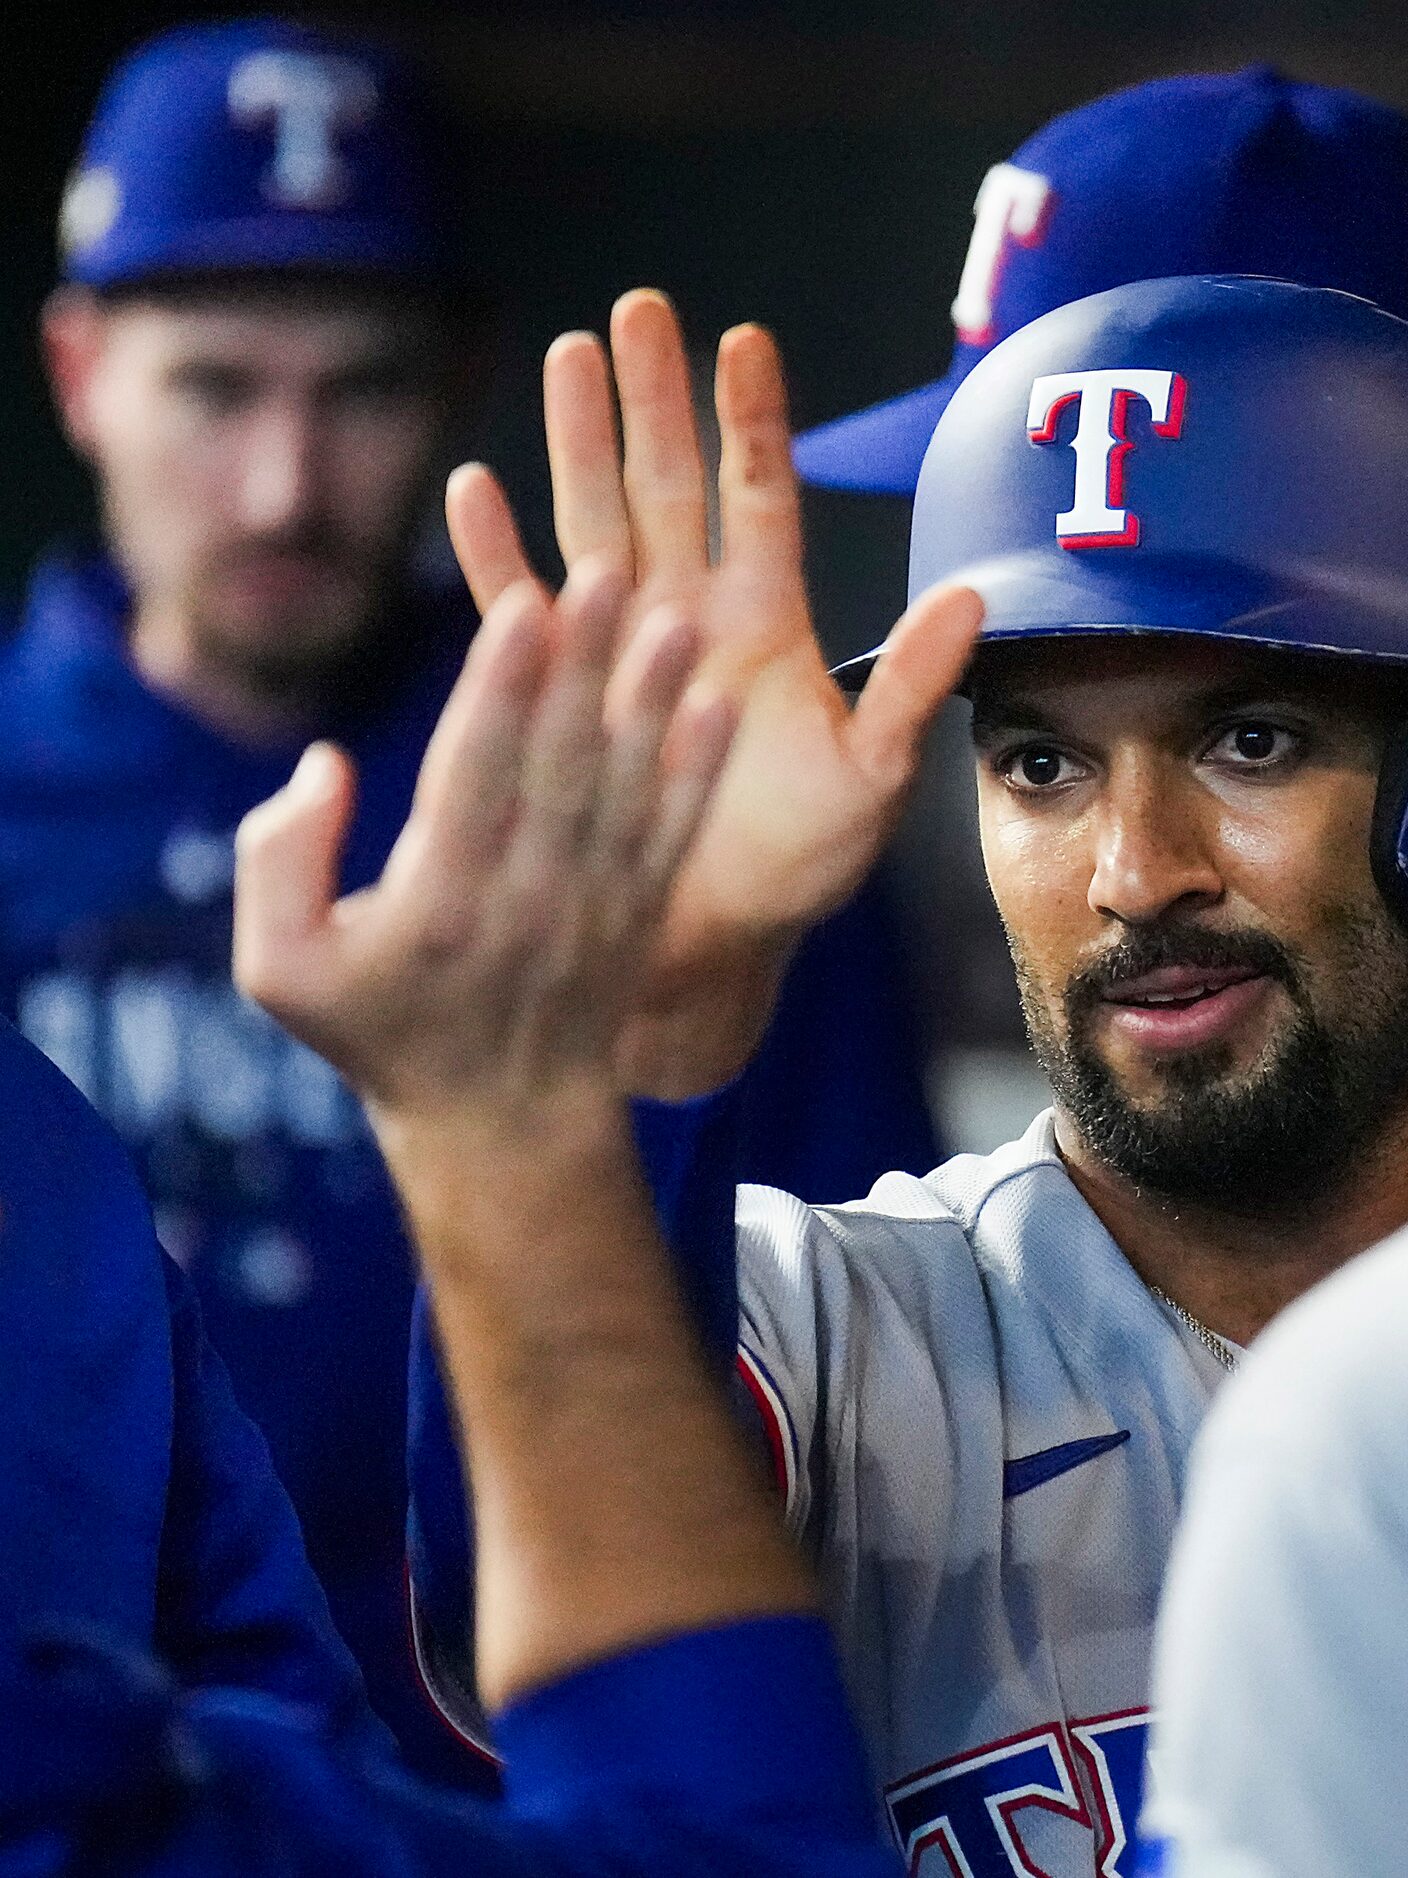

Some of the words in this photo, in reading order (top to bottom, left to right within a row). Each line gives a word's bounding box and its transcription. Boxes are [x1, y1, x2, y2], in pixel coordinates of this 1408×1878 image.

[228, 50, 380, 210] T
[951, 162, 1056, 346] T
[1026, 369, 1188, 549] T
